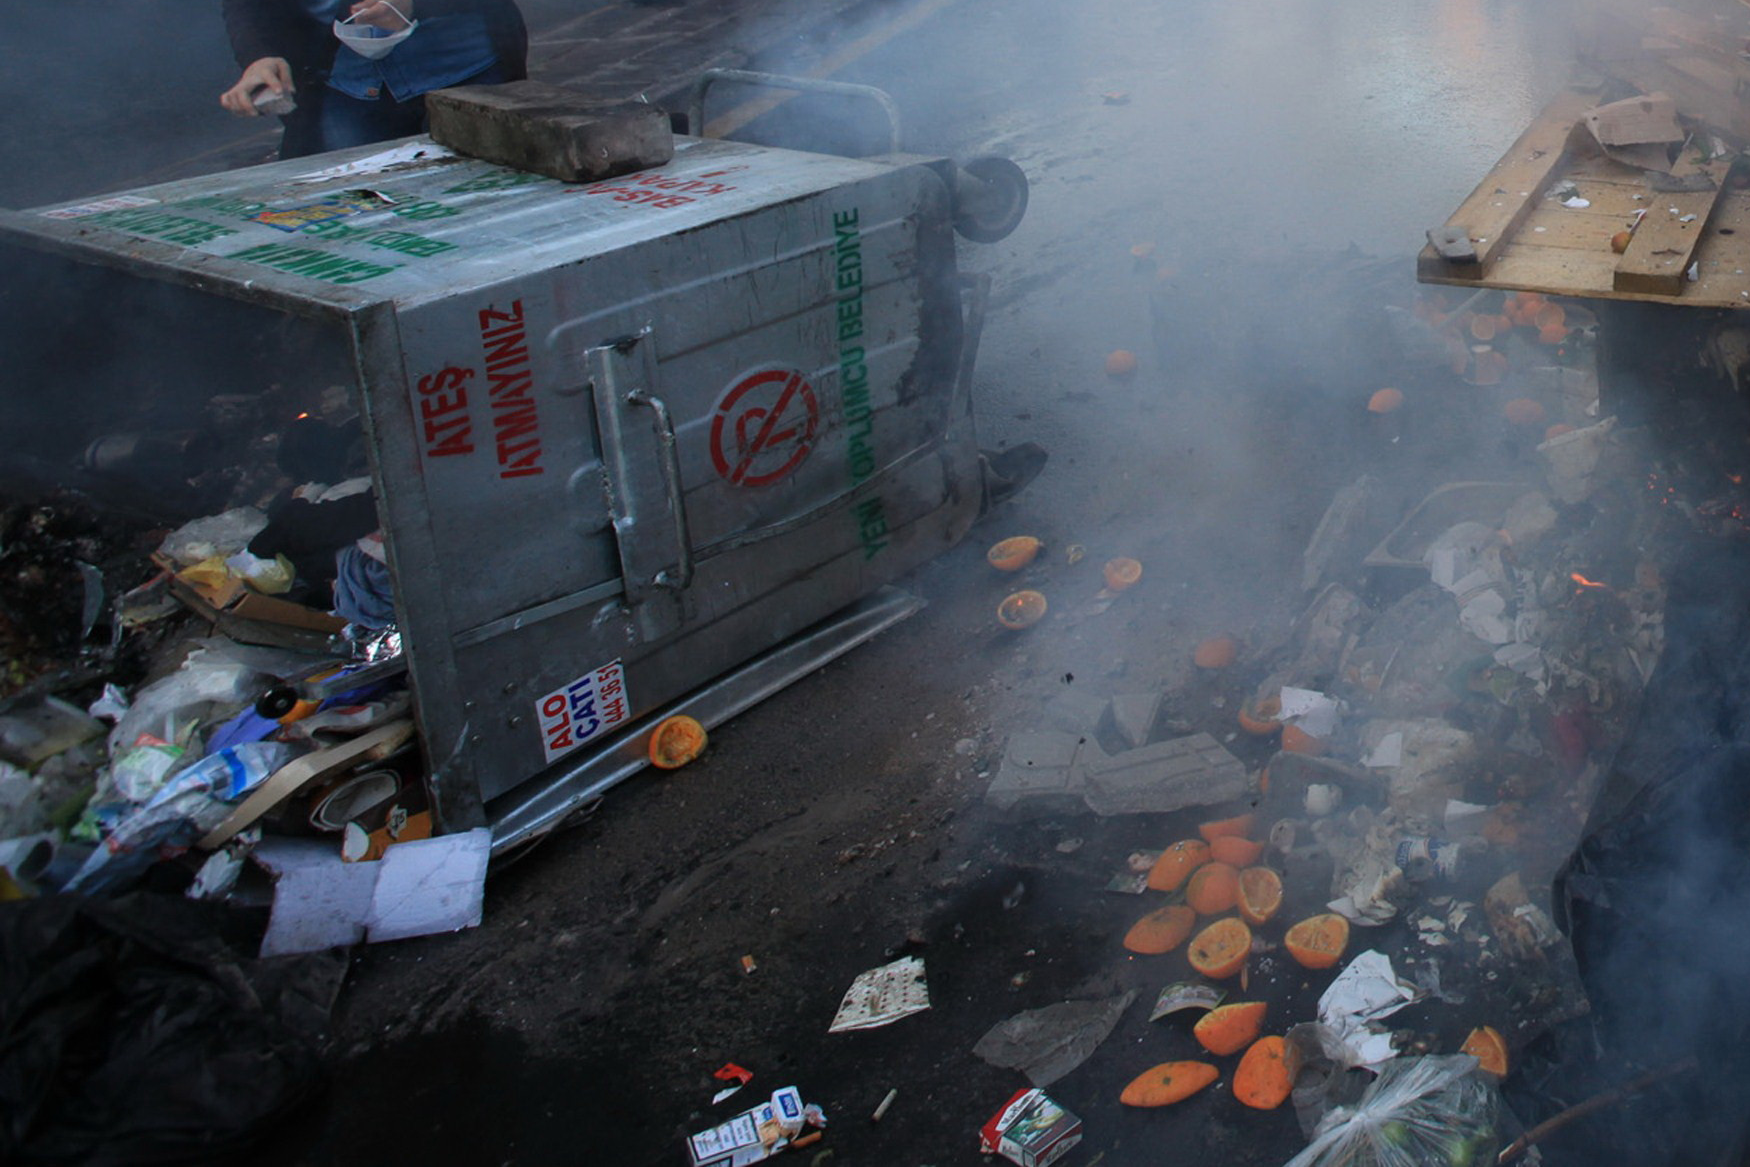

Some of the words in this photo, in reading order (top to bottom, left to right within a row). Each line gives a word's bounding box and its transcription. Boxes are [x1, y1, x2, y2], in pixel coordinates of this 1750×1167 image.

[830, 206, 865, 342] BELEDİYE
[417, 366, 475, 457] ATEŞ
[478, 298, 544, 479] ATMAYINIZ
[841, 345, 876, 487] OPLUMCU
[543, 694, 574, 750] ALO
